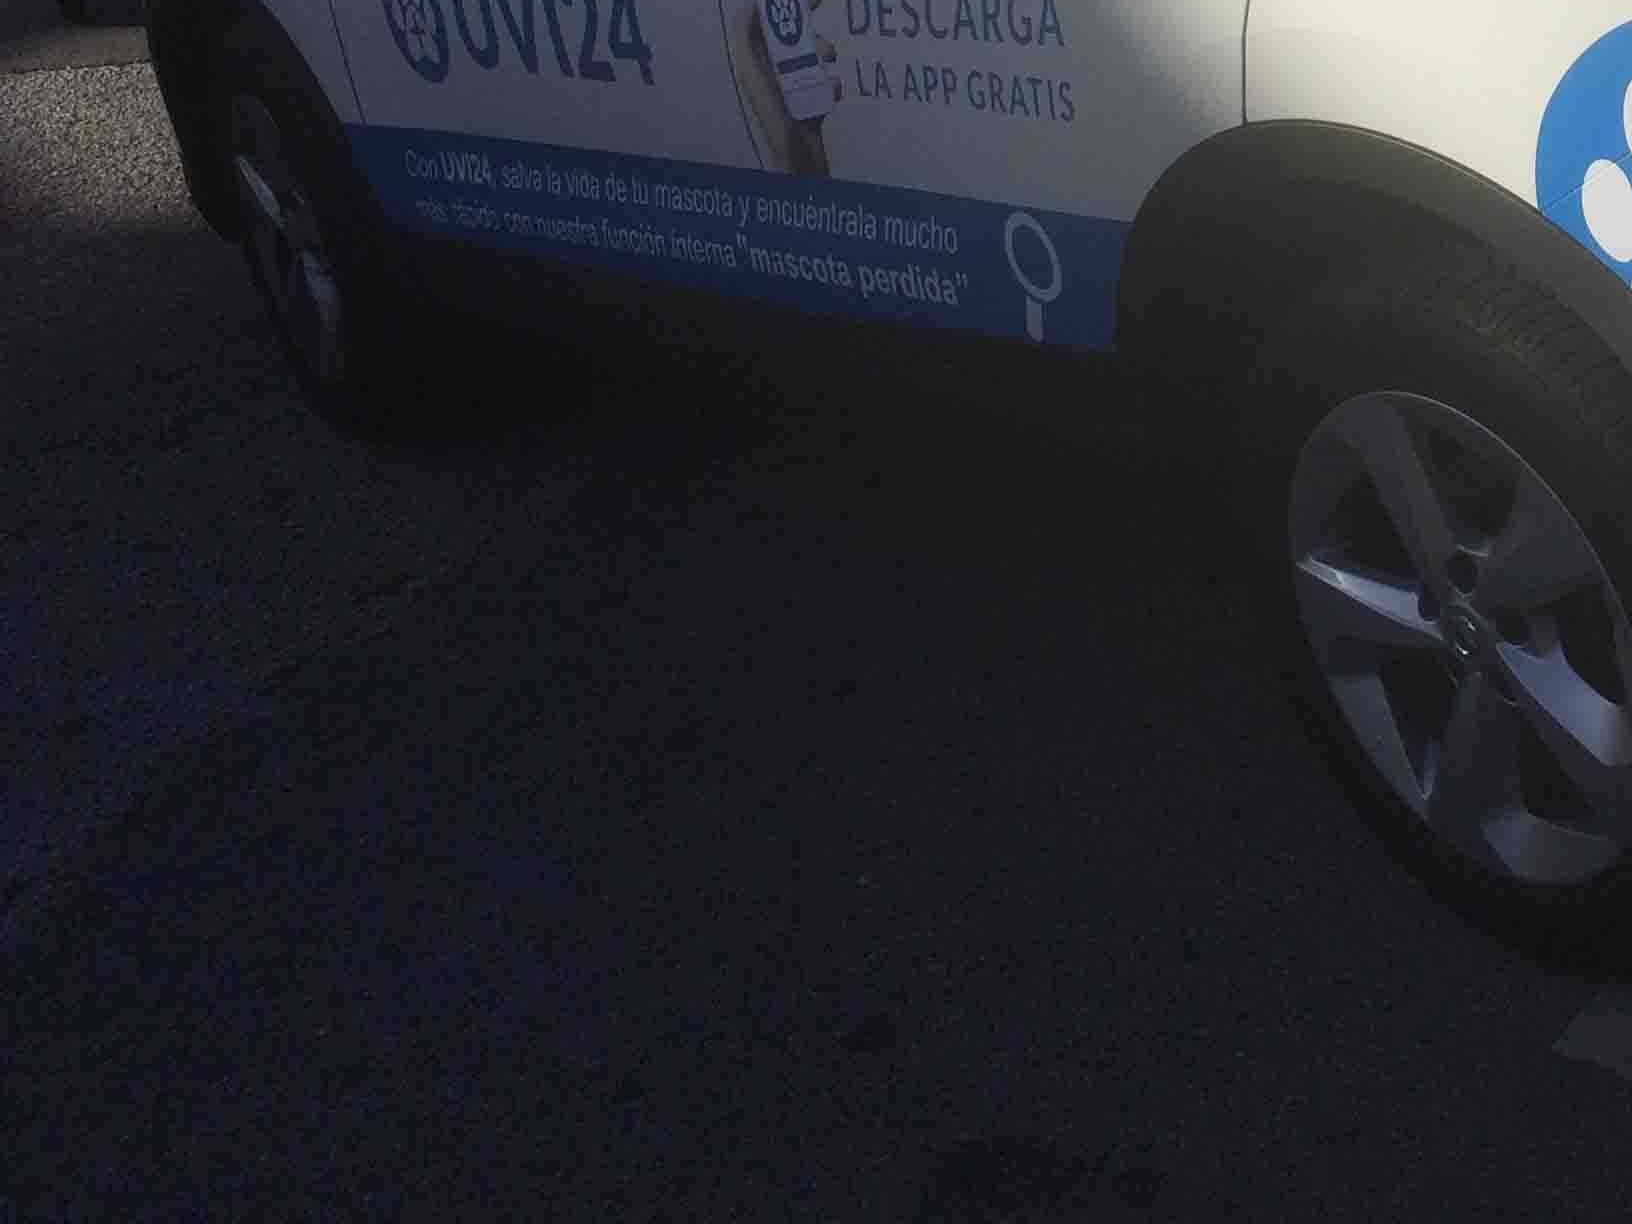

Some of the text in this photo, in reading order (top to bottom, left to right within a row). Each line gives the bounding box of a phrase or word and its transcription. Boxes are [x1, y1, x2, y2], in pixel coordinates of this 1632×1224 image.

[855, 56, 1075, 123] LA APP GRATIS
[404, 148, 441, 184] Con
[502, 158, 544, 192] salva
[543, 159, 562, 196] la
[565, 167, 601, 200] vida
[604, 170, 628, 203] de
[631, 177, 650, 207] tu
[655, 183, 735, 218] mascota
[735, 192, 750, 229] y
[756, 193, 877, 242] encuéntrala
[882, 214, 959, 256] mucho
